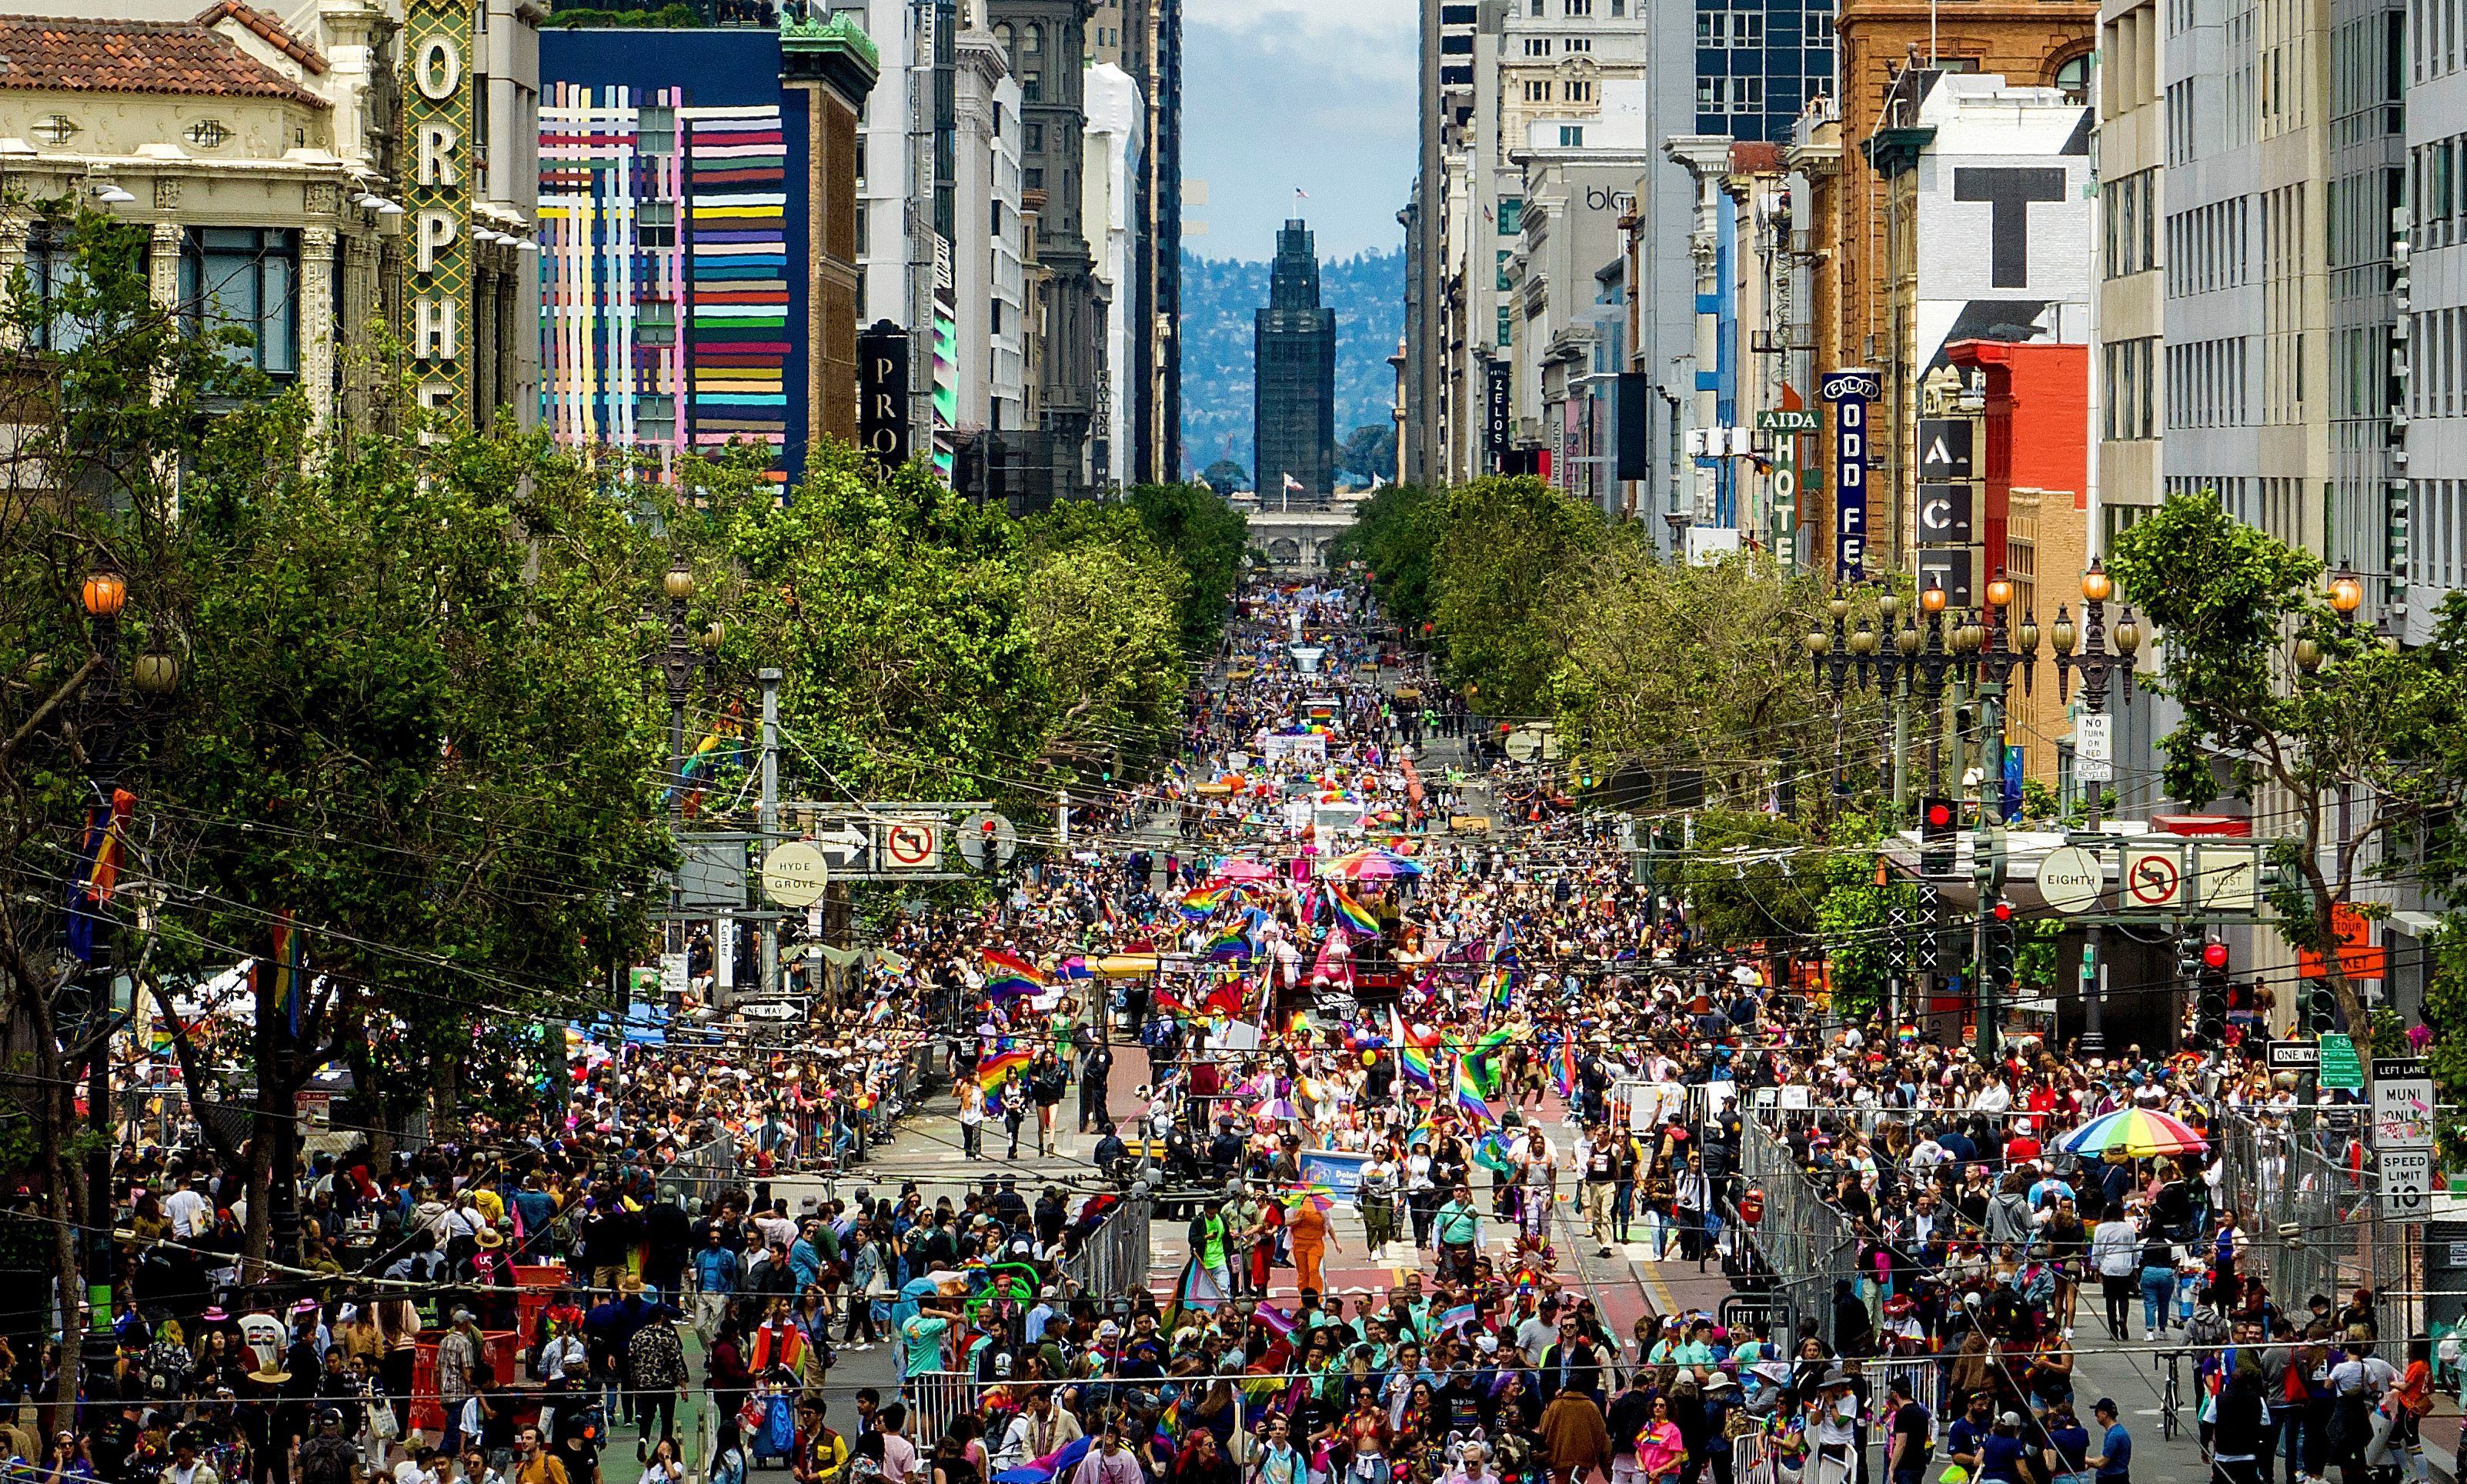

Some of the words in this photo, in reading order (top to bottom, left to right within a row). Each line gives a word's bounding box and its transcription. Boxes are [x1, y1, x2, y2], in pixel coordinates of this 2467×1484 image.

[1954, 166, 2067, 288] T
[414, 32, 462, 491] ORPHE
[1098, 372, 1108, 436] SAVINO
[1494, 379, 1503, 444] ZELOS
[1763, 412, 1818, 428] AIDA
[1552, 421, 1562, 481] NORDSTROM
[1843, 403, 1860, 487] ODD
[1774, 435, 1794, 564] HOTE
[2085, 719, 2101, 728] NO
[779, 862, 811, 871] HYDE
[774, 880, 816, 889] GROVE
[2048, 875, 2095, 885] EIGHTH
[2212, 876, 2243, 886] MUST
[721, 925, 729, 957] Center
[2314, 956, 2368, 969] MKET
[2277, 1049, 2299, 1060] ONE
[2303, 1049, 2319, 1060] WA
[2379, 1066, 2399, 1075] LEFT
[2403, 1065, 2426, 1075] LANE
[2386, 1089, 2421, 1100] MUNI
[2384, 1157, 2426, 1167] SPEED
[2389, 1171, 2422, 1181] LIMIT
[2391, 1186, 2421, 1209] 10
[1731, 1310, 1753, 1323] LEFT
